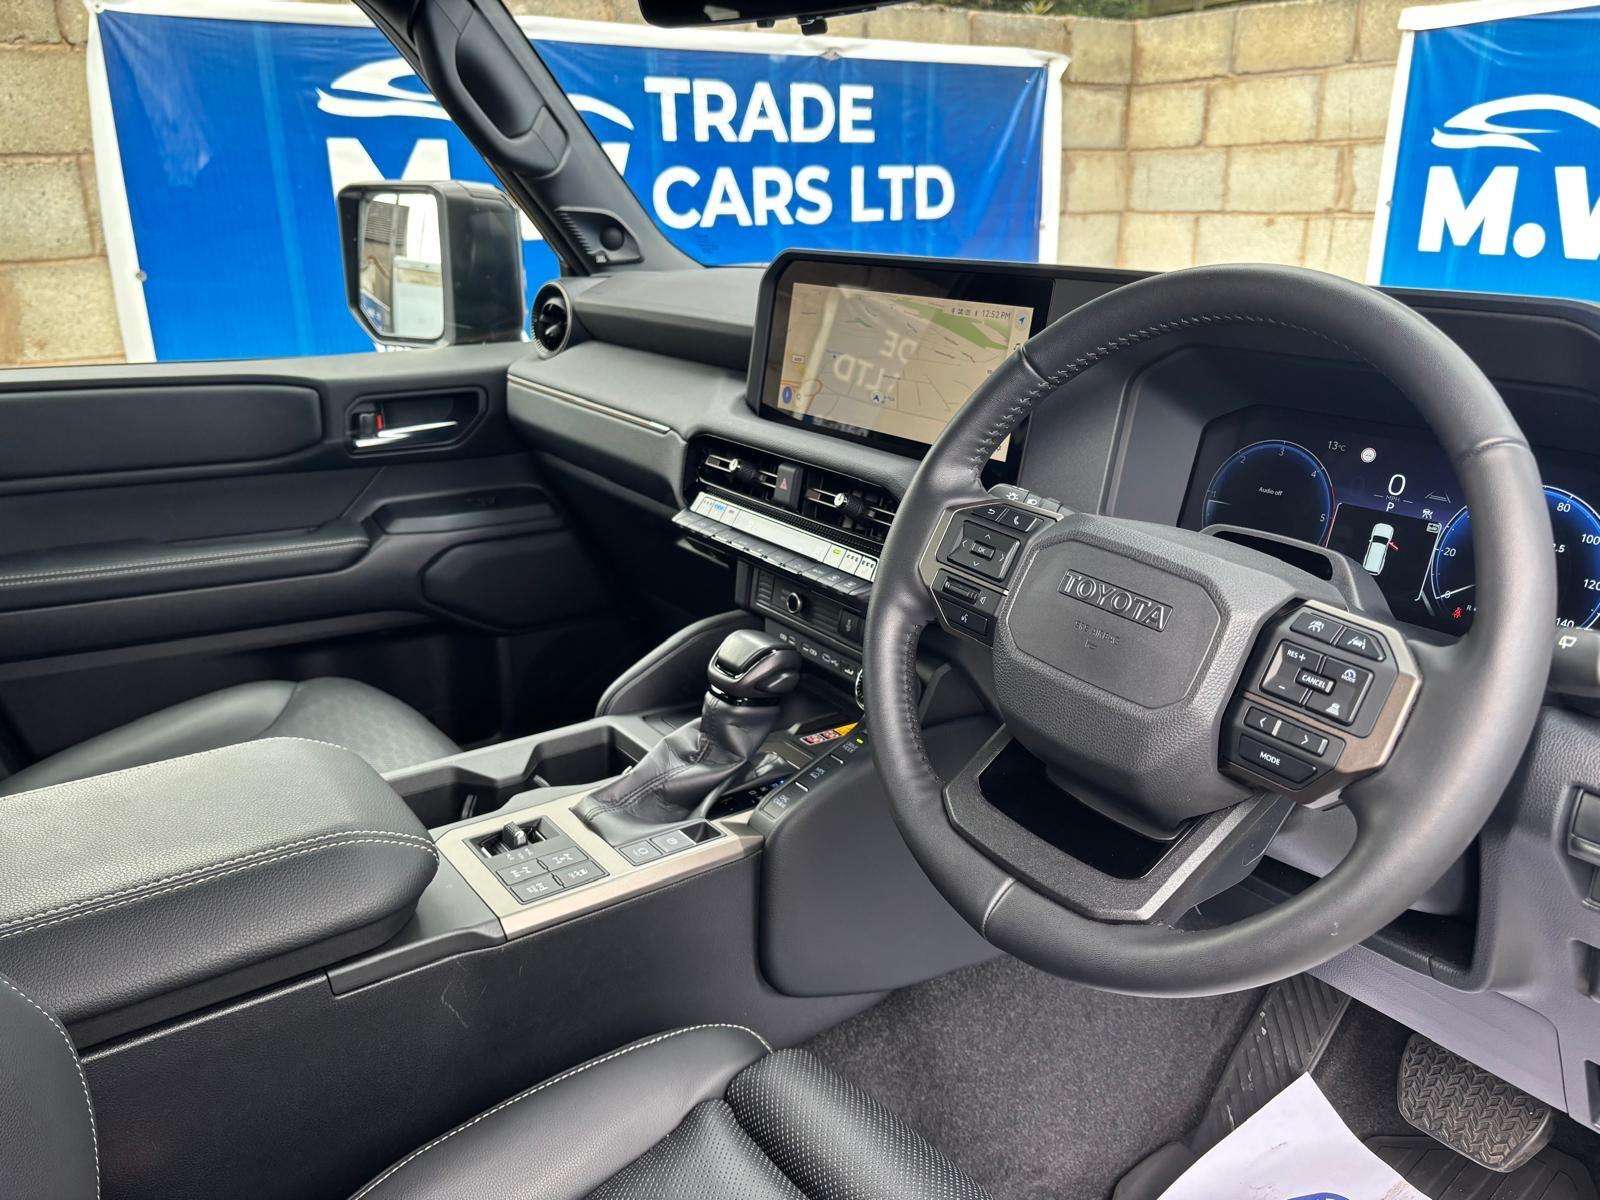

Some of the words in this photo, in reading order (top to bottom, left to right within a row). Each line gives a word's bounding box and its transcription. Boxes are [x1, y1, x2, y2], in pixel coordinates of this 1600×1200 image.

[644, 76, 876, 144] TRADE
[652, 165, 833, 229] CARS
[850, 164, 956, 223] LTD
[982, 309, 999, 320] 12:52
[1000, 311, 1012, 320] PM
[1279, 447, 1285, 457] 3
[1240, 455, 1247, 465] 2
[1311, 470, 1318, 479] 4
[1387, 473, 1406, 496] 0
[1258, 486, 1274, 495] Audio
[1274, 489, 1284, 497] off
[1386, 501, 1395, 513] P
[1557, 502, 1571, 513] 80
[1320, 513, 1327, 522] 5
[1443, 547, 1457, 557] 20
[1444, 590, 1451, 599] 0
[1064, 572, 1165, 629] TOYOTA
[1466, 604, 1472, 612] R
[1555, 617, 1575, 629] 140
[1286, 649, 1299, 659] RES
[1301, 674, 1327, 689] CANCEL
[1259, 751, 1281, 766] MODE
